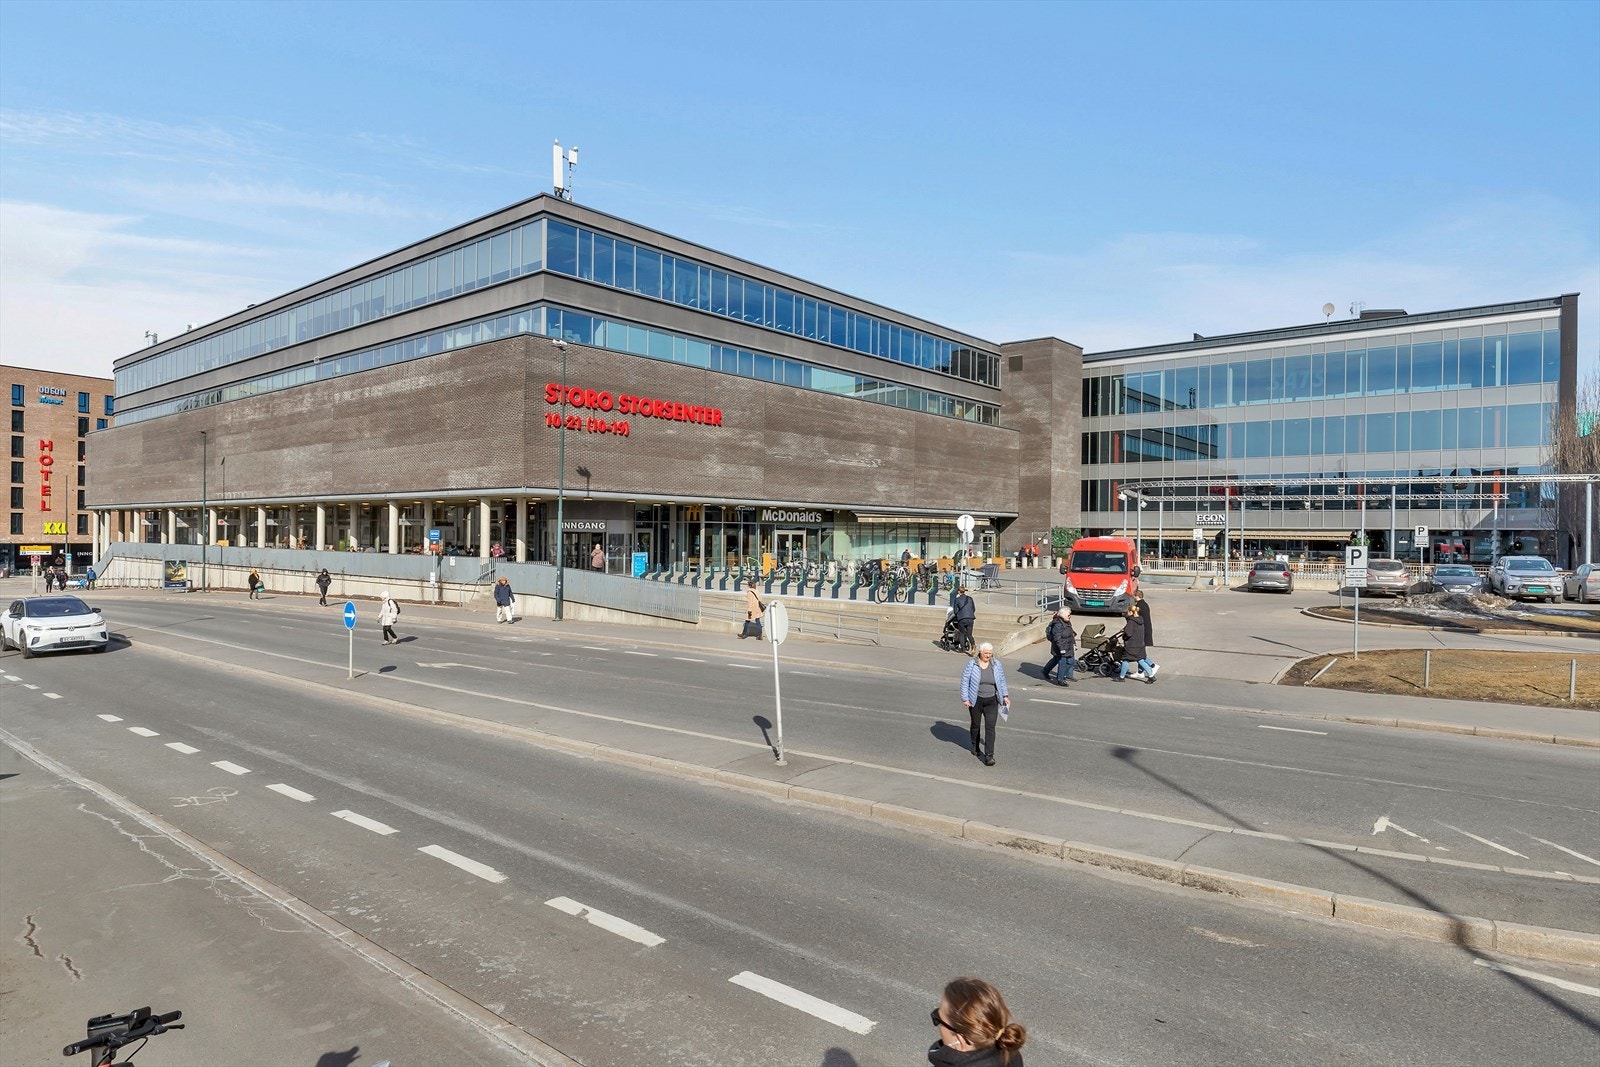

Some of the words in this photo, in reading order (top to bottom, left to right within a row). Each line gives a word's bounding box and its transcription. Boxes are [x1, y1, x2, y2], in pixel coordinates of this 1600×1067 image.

[545, 383, 614, 412] STORO
[618, 394, 723, 427] STORSENTER
[586, 416, 630, 437] (10-19)
[39, 440, 53, 511] HOTEL
[761, 509, 822, 523] McDonald's
[1196, 514, 1225, 522] EGON
[561, 522, 606, 530] INNGANG
[1418, 527, 1425, 535] P
[1351, 549, 1362, 565] P
